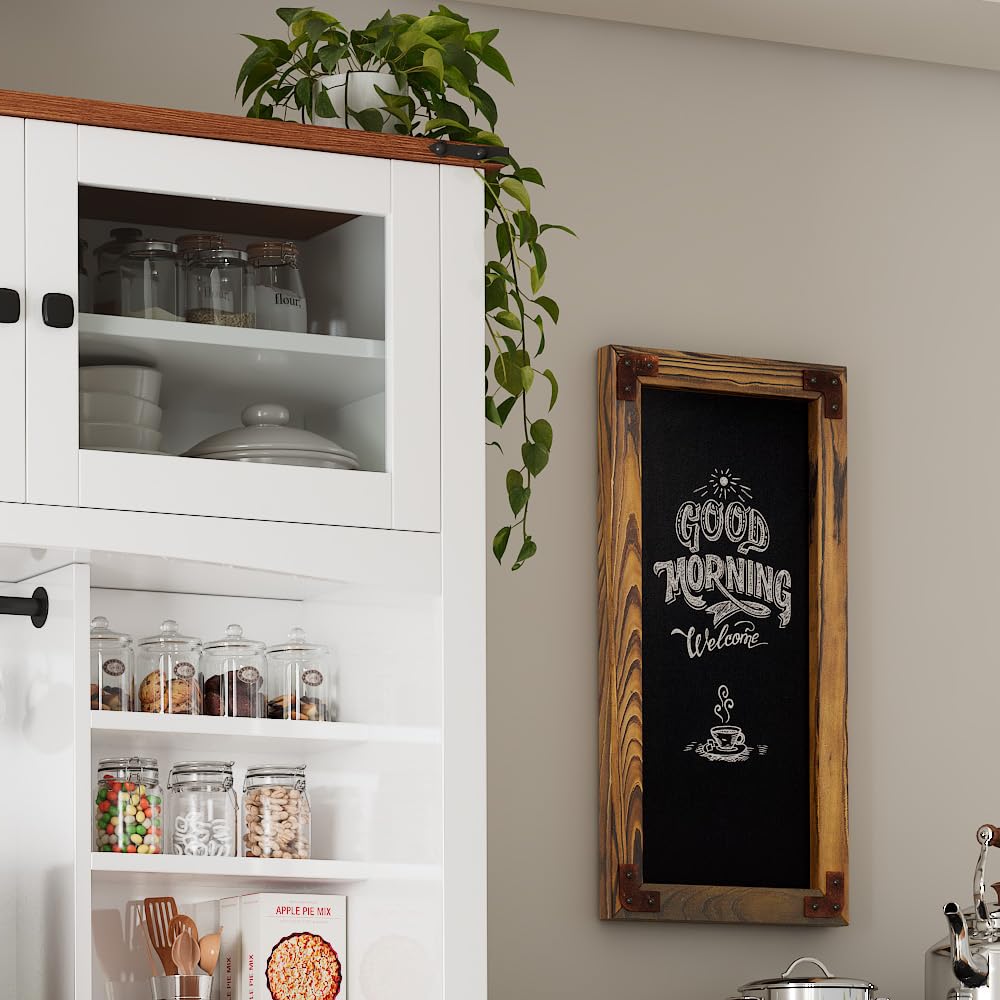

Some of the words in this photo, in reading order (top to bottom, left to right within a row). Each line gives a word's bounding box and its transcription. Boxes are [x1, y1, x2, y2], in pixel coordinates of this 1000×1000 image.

[675, 499, 770, 555] GOOD
[653, 554, 791, 628] MORNING
[671, 620, 768, 658] Welcome
[275, 906, 301, 916] APPLE
[302, 906, 315, 916] PIE
[317, 907, 331, 916] MIX
